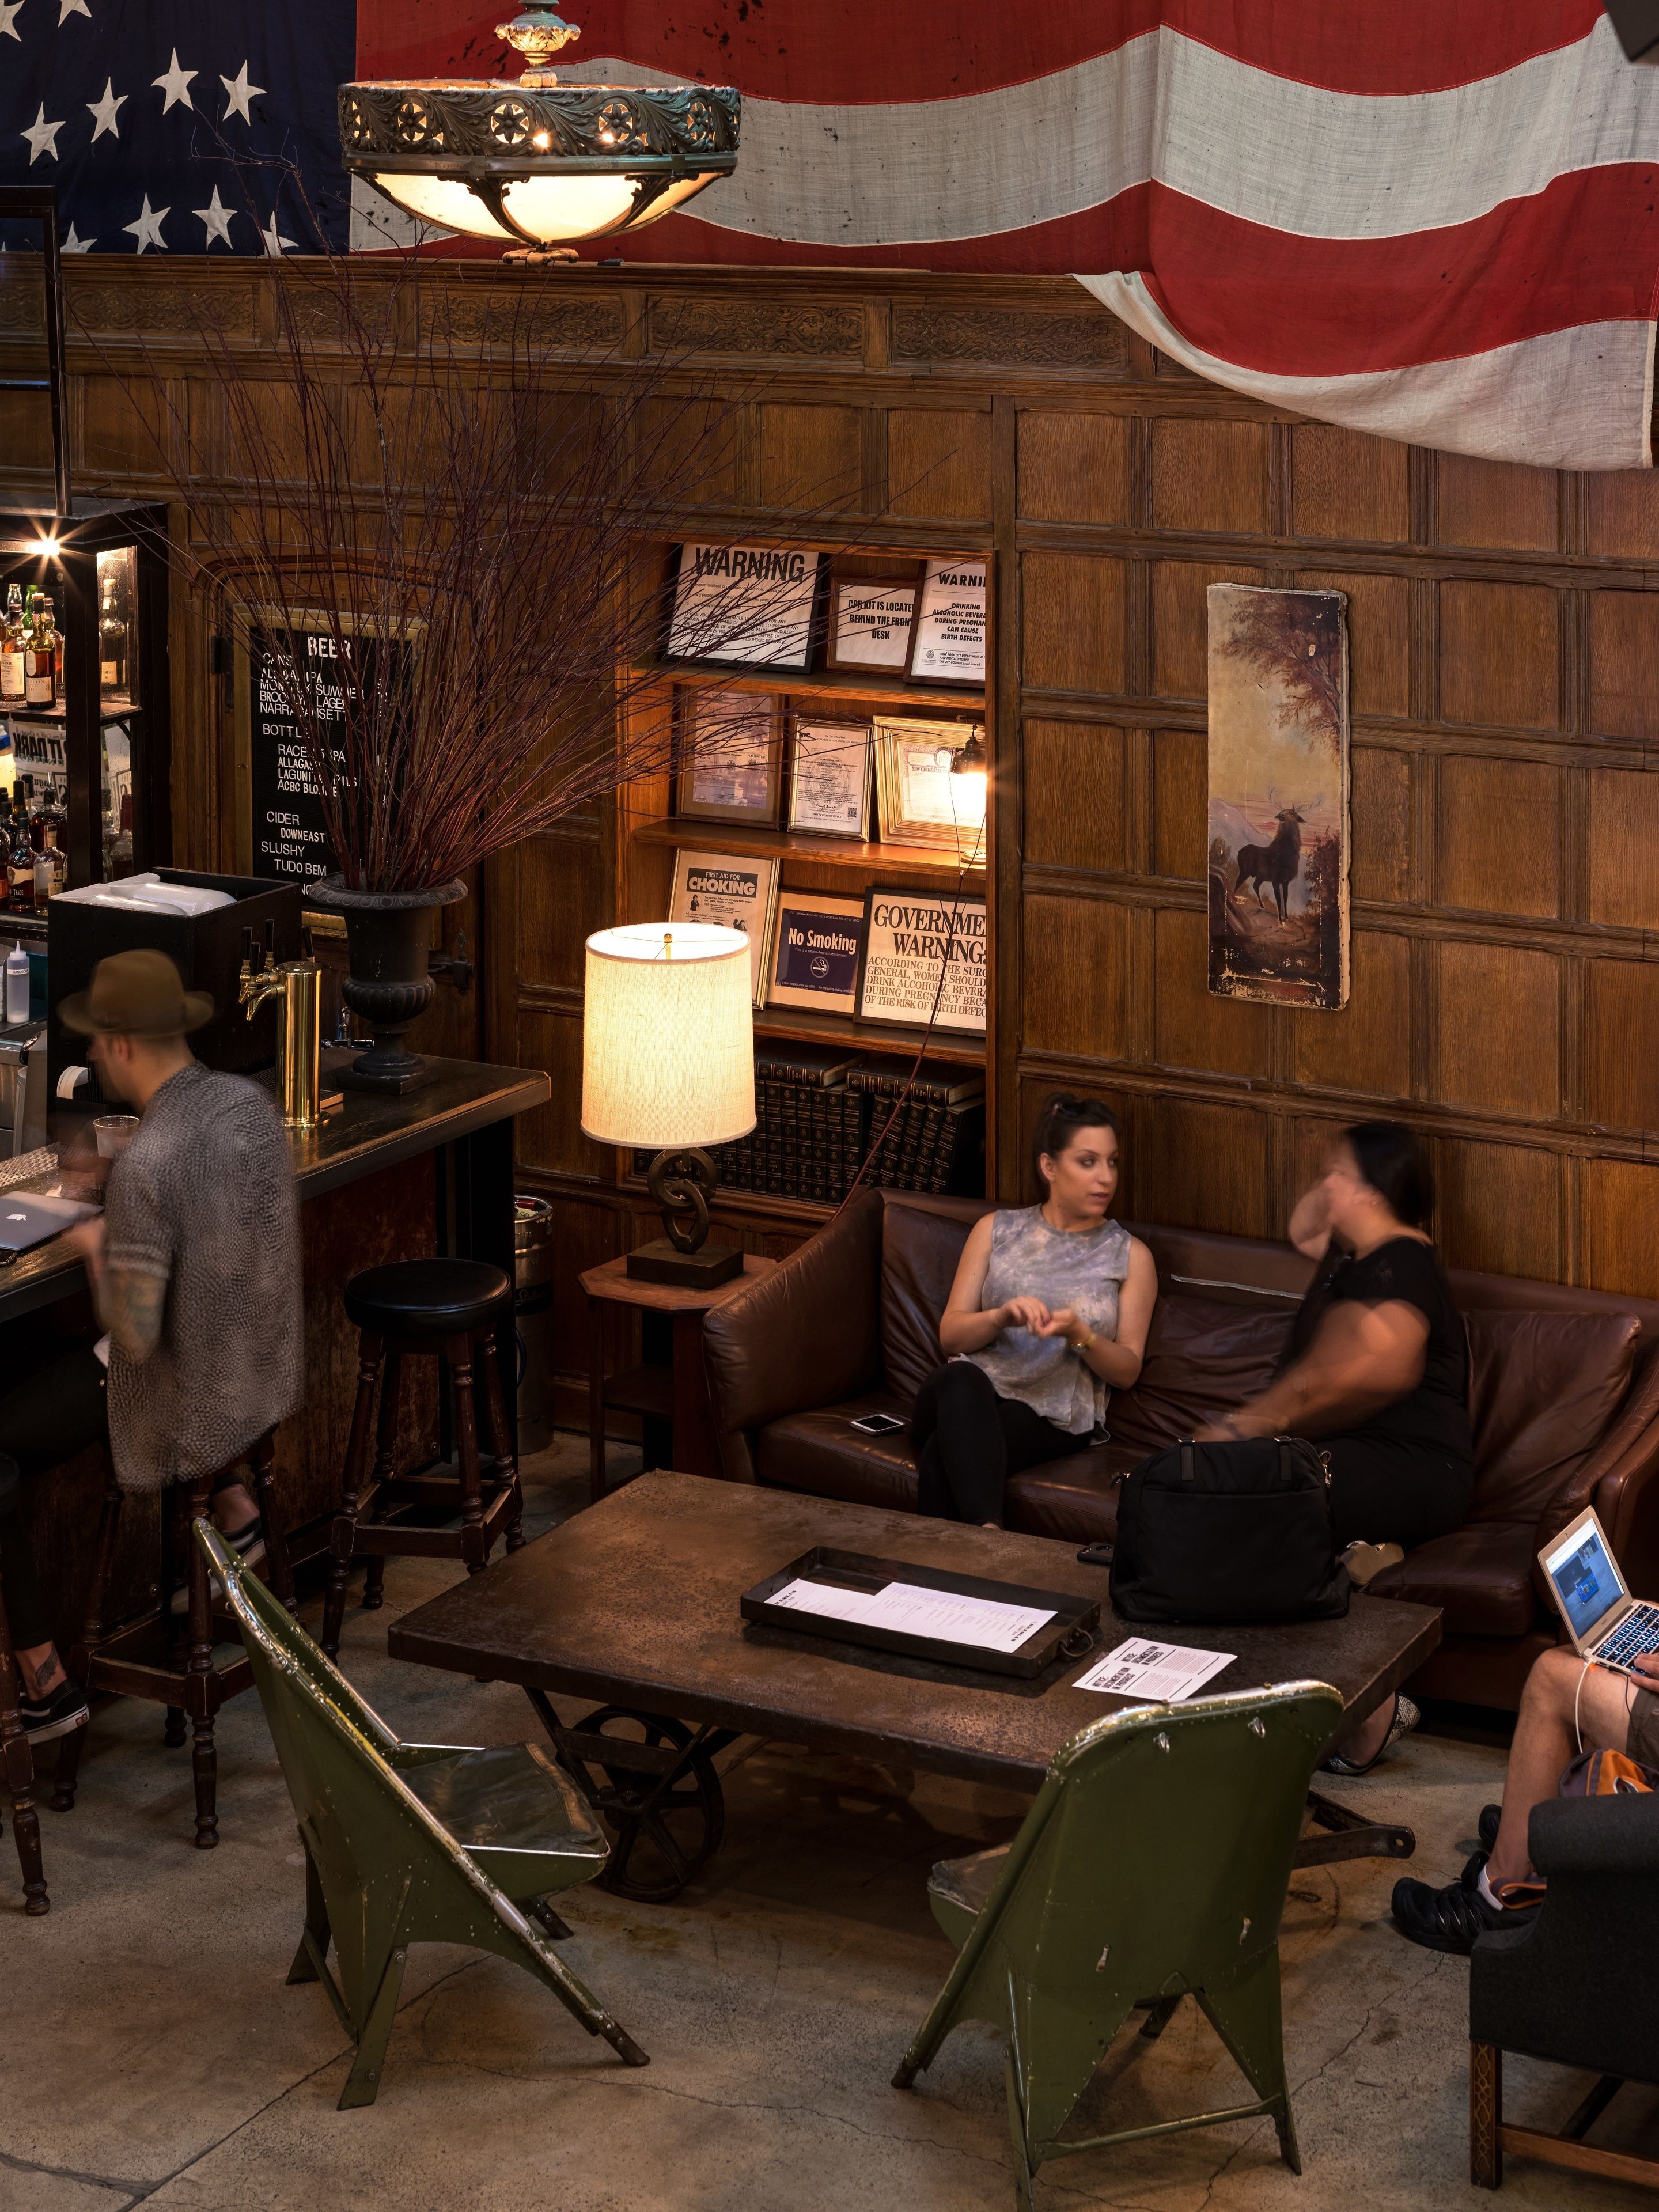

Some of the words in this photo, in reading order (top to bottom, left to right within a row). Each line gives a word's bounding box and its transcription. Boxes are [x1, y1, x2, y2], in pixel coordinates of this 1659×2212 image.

[695, 547, 805, 583] WARNING
[848, 599, 862, 608] CPR
[864, 601, 875, 609] KIT
[877, 602, 884, 610] IS
[849, 614, 876, 624] BEHIND
[877, 616, 890, 626] THE
[892, 618, 912, 627] FRON
[872, 630, 890, 640] DESK
[308, 637, 351, 660] BEER
[263, 653, 293, 666] CNS
[278, 744, 315, 759] RACE
[277, 779, 300, 793] ACBC
[266, 810, 300, 825] CIDER
[281, 827, 325, 843] DOWNEAST
[261, 841, 305, 857] SLUSHY
[274, 859, 303, 873] TUDO
[305, 863, 327, 876] BEM
[688, 877, 755, 896] CHOKING
[874, 904, 986, 938] GOVERNME
[788, 927, 804, 946] No
[806, 930, 857, 955] Smoking
[868, 956, 923, 970] ACCORDING
[926, 962, 939, 972] TO
[941, 964, 961, 974] THE
[866, 975, 895, 987] DRINK
[897, 979, 950, 993] ALCOHOLIC
[868, 965, 911, 980] GENERAL,
[914, 971, 947, 983] WOMEN
[950, 975, 986, 987] SHOULD
[866, 985, 902, 998] DURING
[865, 995, 877, 1004] OF
[878, 997, 895, 1006] THE
[896, 998, 916, 1009] RISK
[918, 1001, 930, 1010] OF
